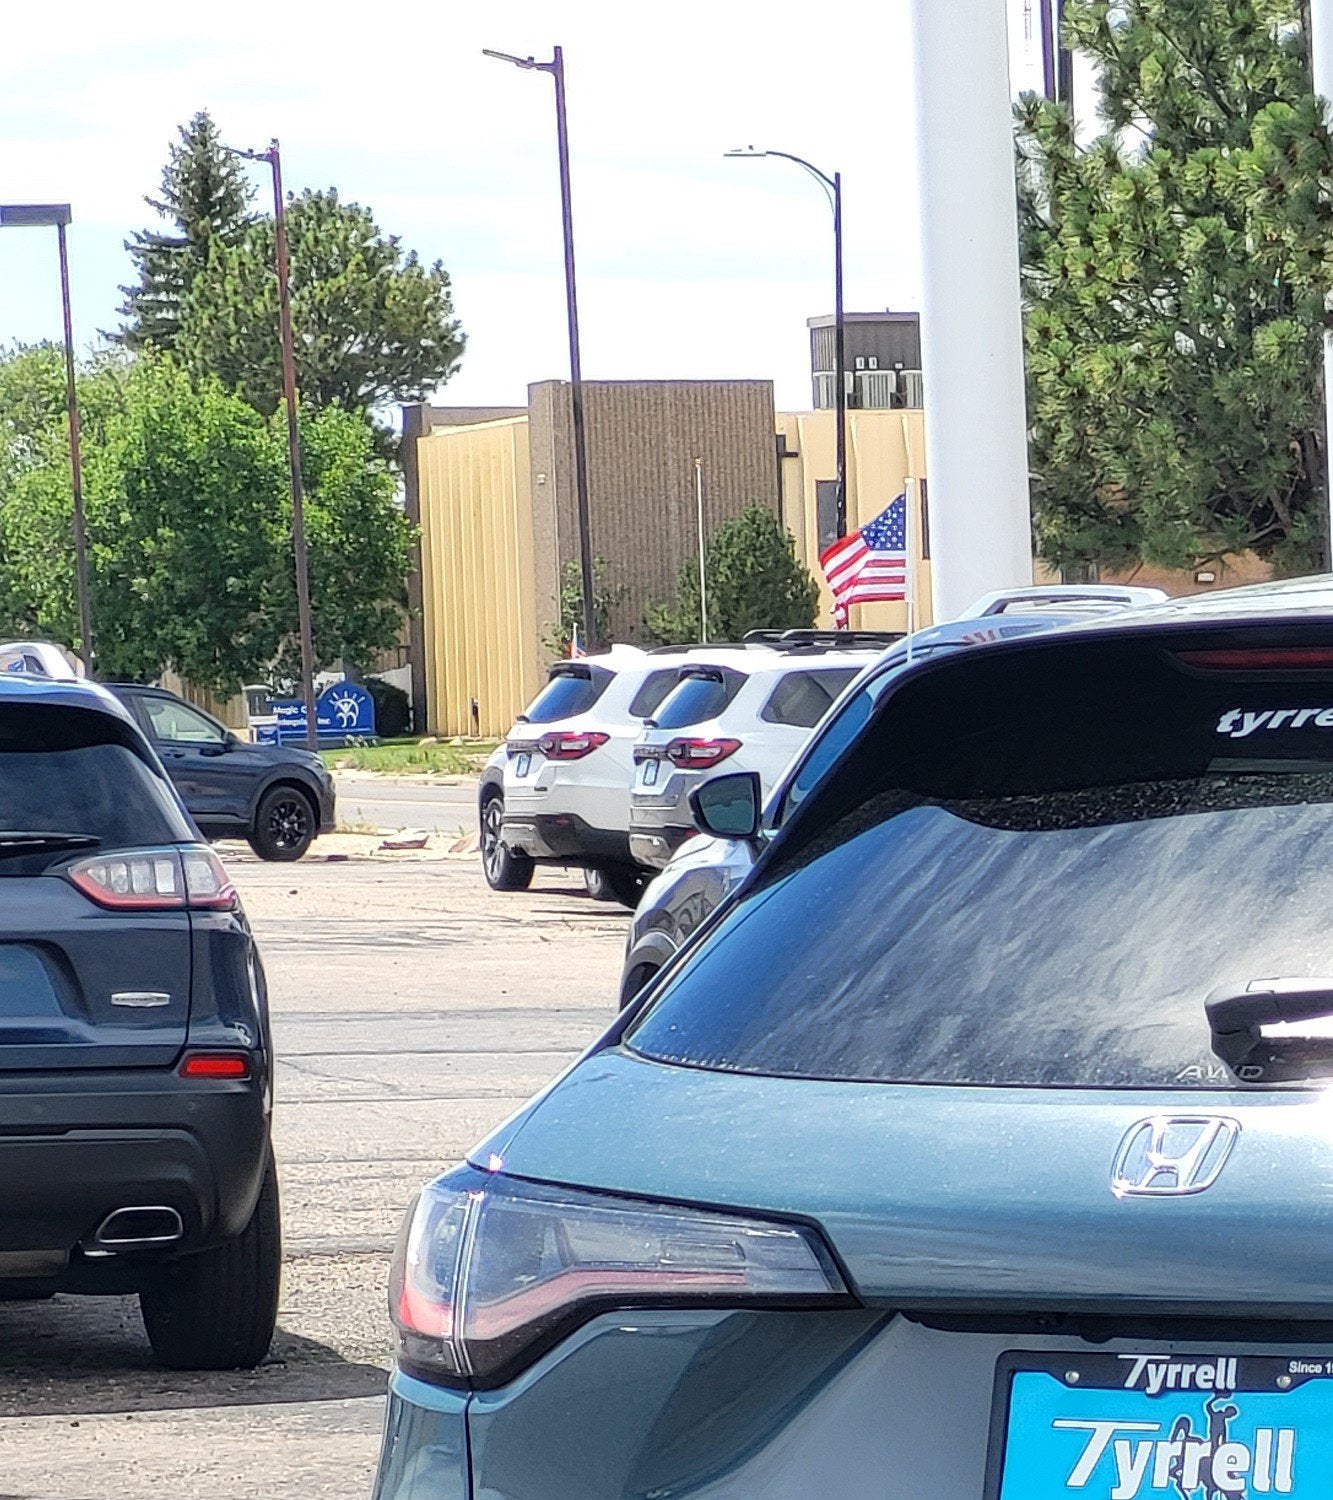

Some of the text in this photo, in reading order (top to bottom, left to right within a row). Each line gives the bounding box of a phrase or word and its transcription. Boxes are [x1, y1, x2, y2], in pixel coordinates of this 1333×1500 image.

[1176, 1065, 1264, 1080] AWD
[1117, 1354, 1238, 1395] Tyrrell
[1288, 1360, 1323, 1374] Since
[1052, 1418, 1296, 1500] Tyrrell
